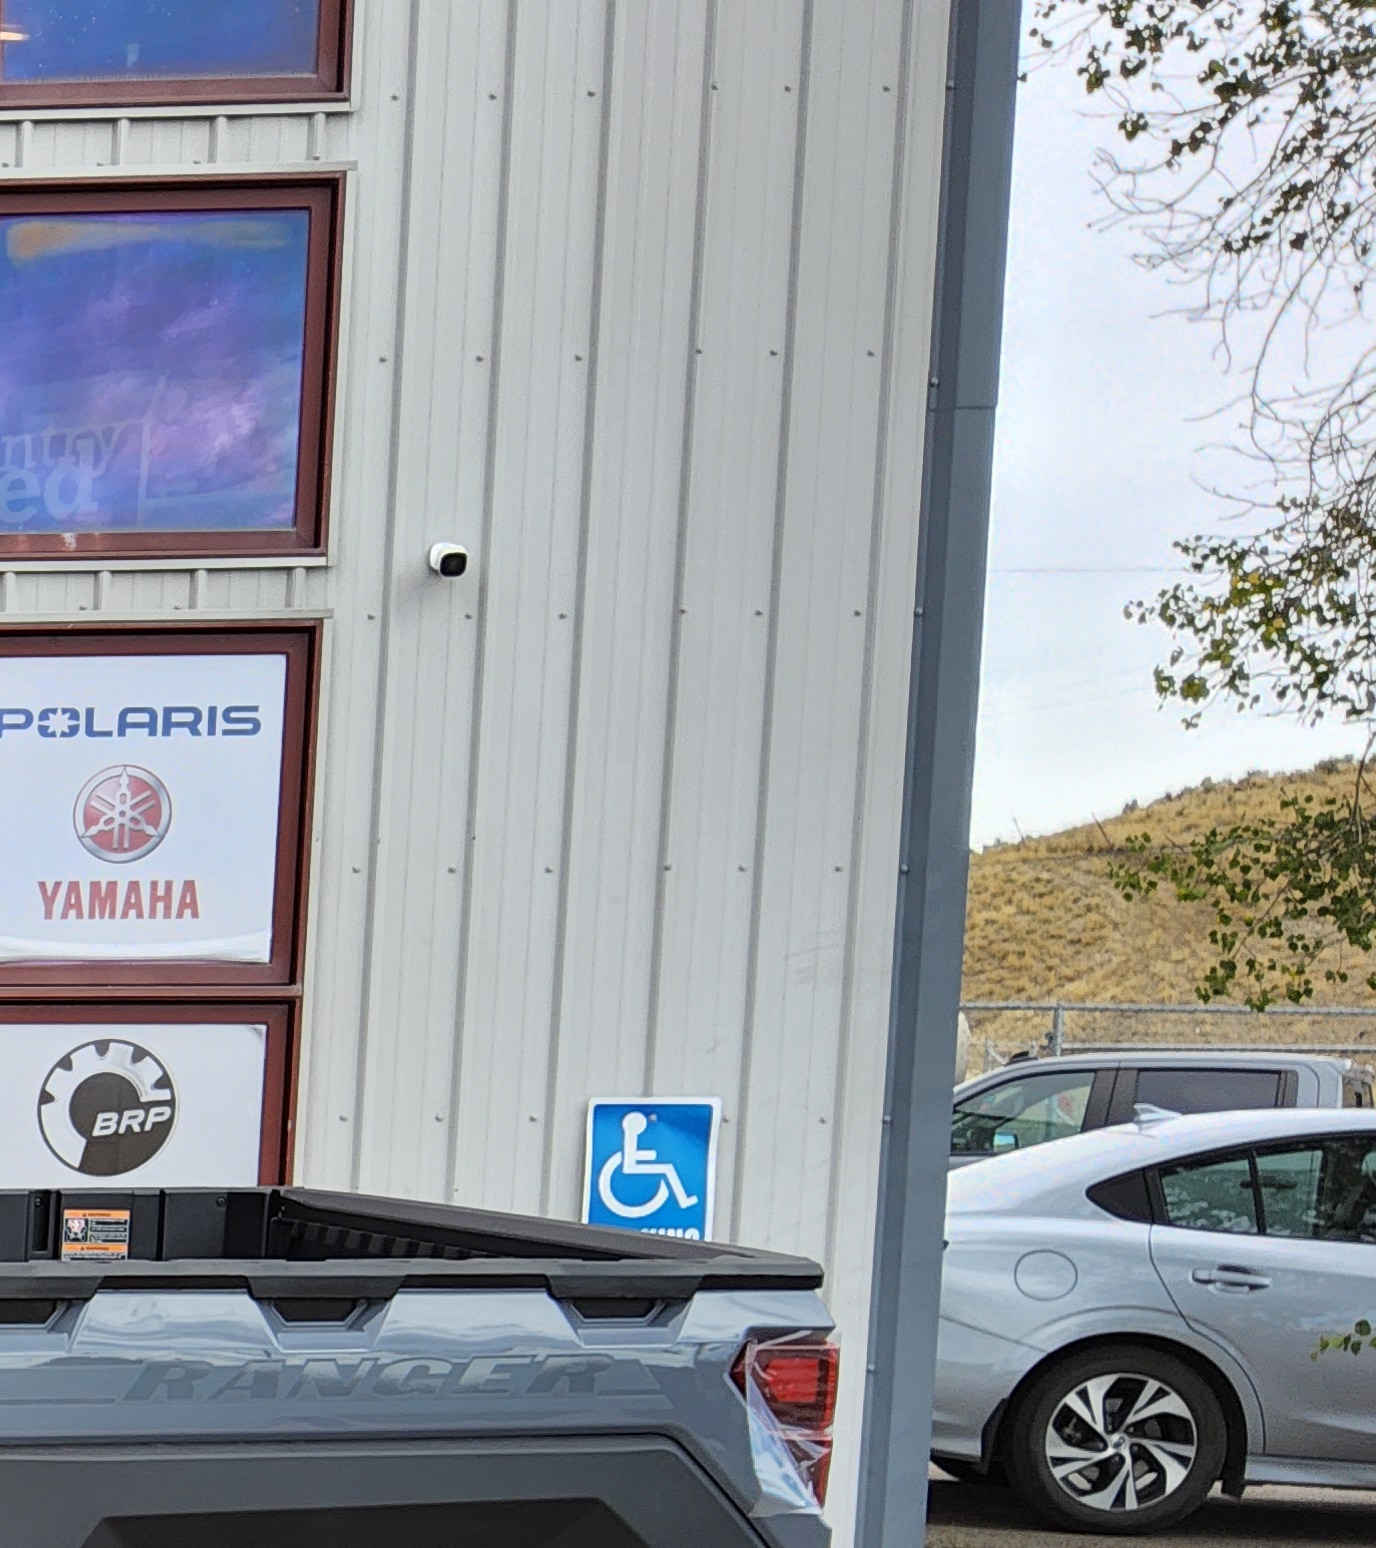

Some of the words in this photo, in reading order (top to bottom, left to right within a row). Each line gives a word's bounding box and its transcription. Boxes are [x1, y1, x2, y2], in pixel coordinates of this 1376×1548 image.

[37, 880, 200, 920] YAMAHA
[91, 1105, 172, 1138] BRP
[116, 1354, 619, 1401] RANGER
